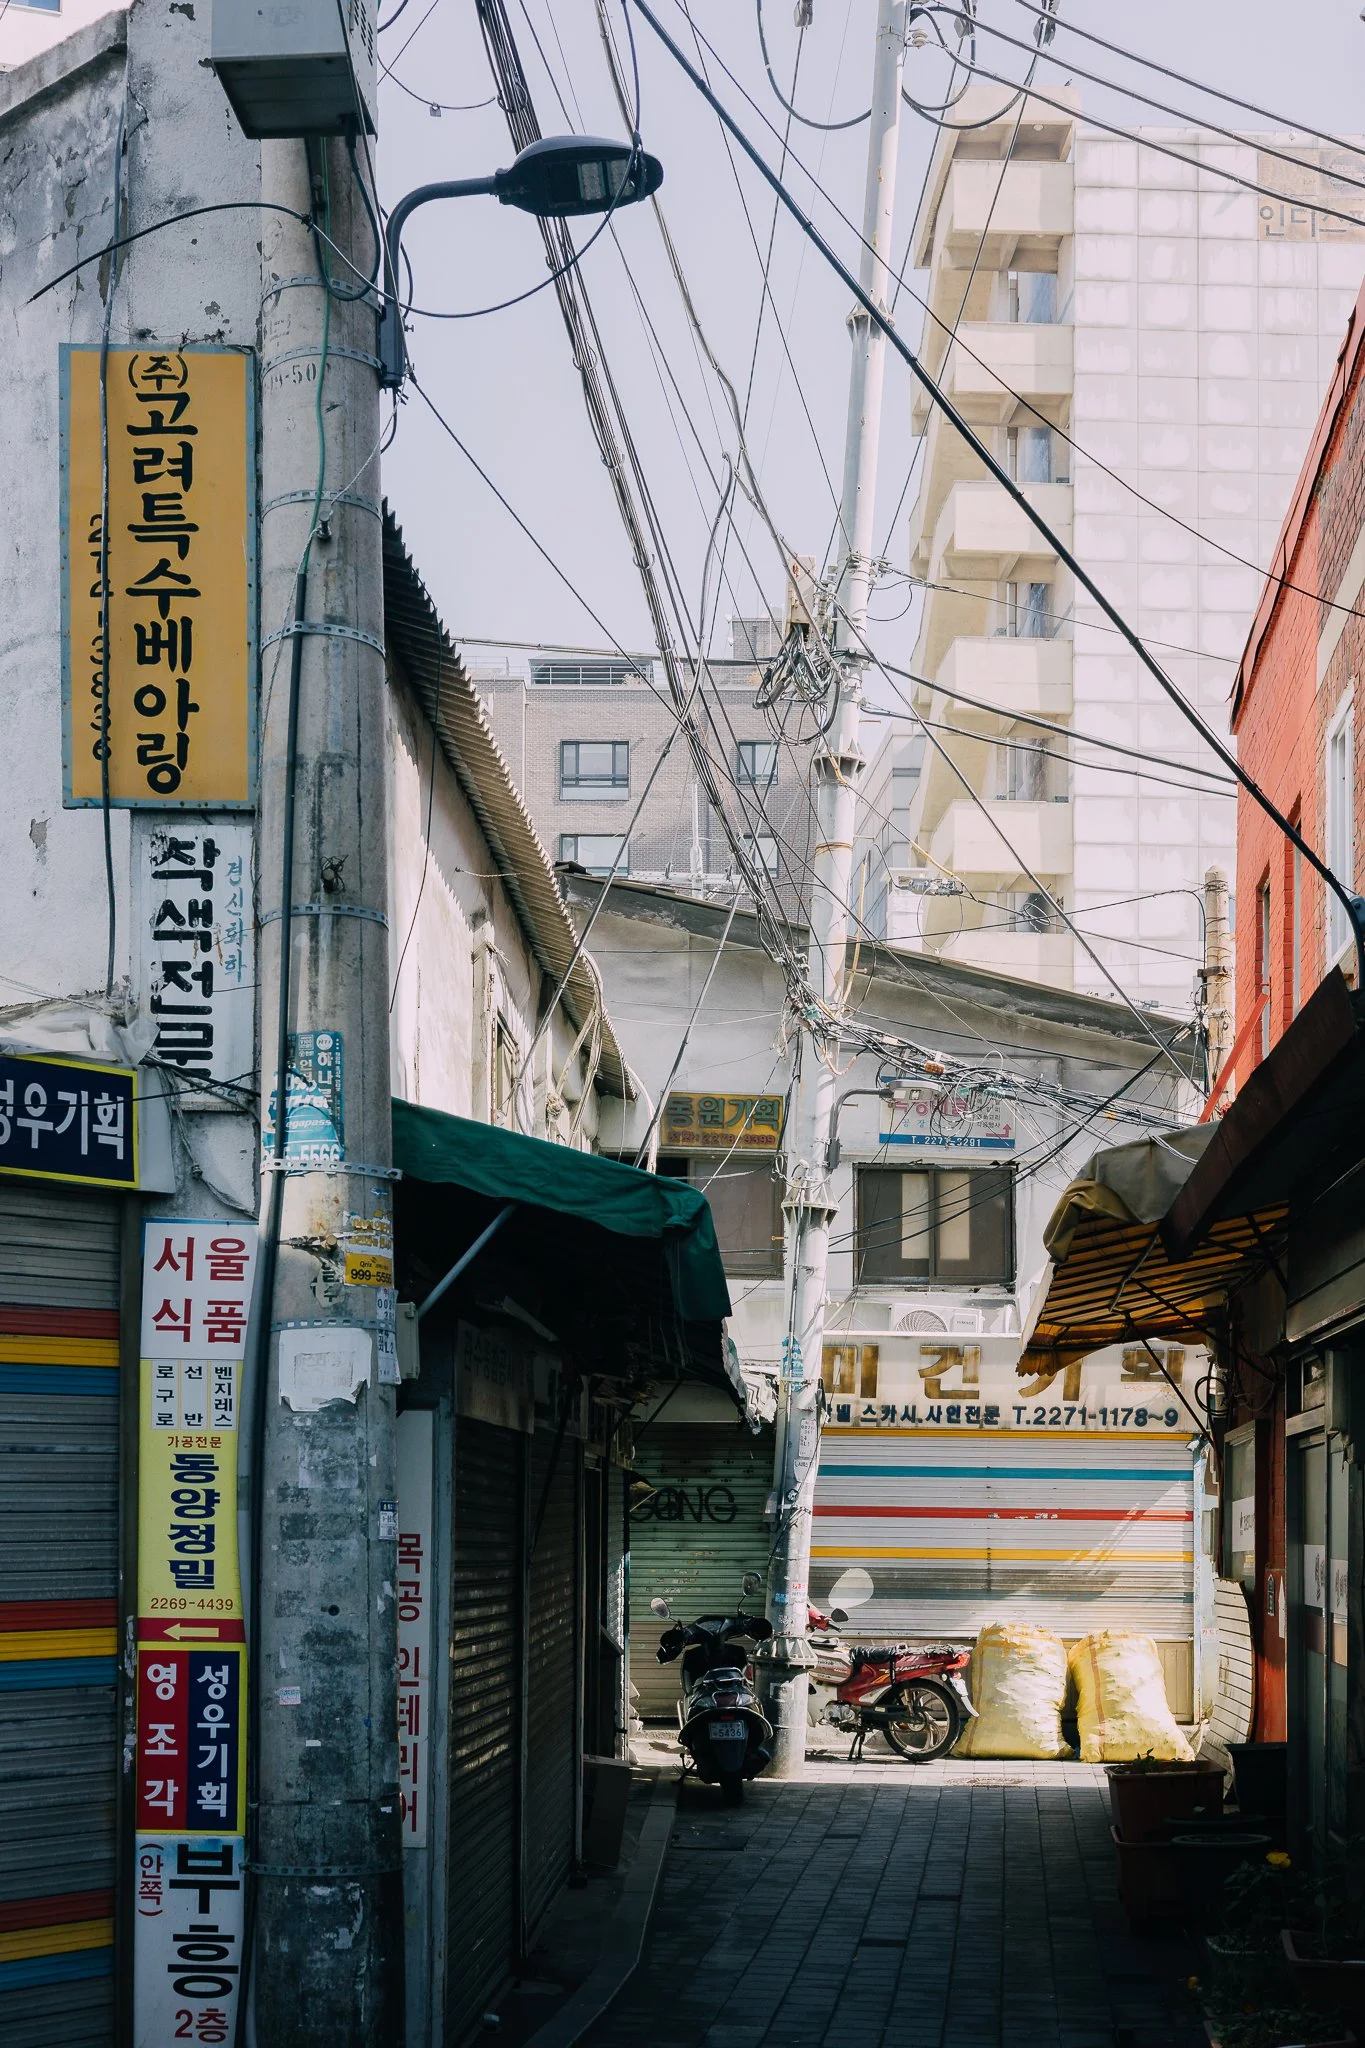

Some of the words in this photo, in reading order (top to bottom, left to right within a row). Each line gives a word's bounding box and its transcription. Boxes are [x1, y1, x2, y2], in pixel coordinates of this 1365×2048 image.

[286, 1118, 332, 1128] egapass
[667, 1096, 780, 1131] 동원기획
[153, 1237, 250, 1282] 서울
[152, 1298, 247, 1343] 식품
[156, 1365, 175, 1426] 로구로
[184, 1366, 203, 1426] 선반
[214, 1366, 233, 1427] 벤지레스
[1012, 1405, 1178, 1428] T.2271-1178~9
[168, 1436, 222, 1448] 가공전문
[167, 1454, 220, 1590] 동양정밀
[151, 1598, 234, 1611] 2269-4439
[144, 1663, 179, 1817] 영조각
[197, 1665, 230, 1818] 성우기획
[718, 1728, 742, 1737] 5436
[138, 1843, 164, 1917] (안쪽)
[168, 1843, 240, 1999] 부흥
[174, 2008, 229, 2043] 2층
